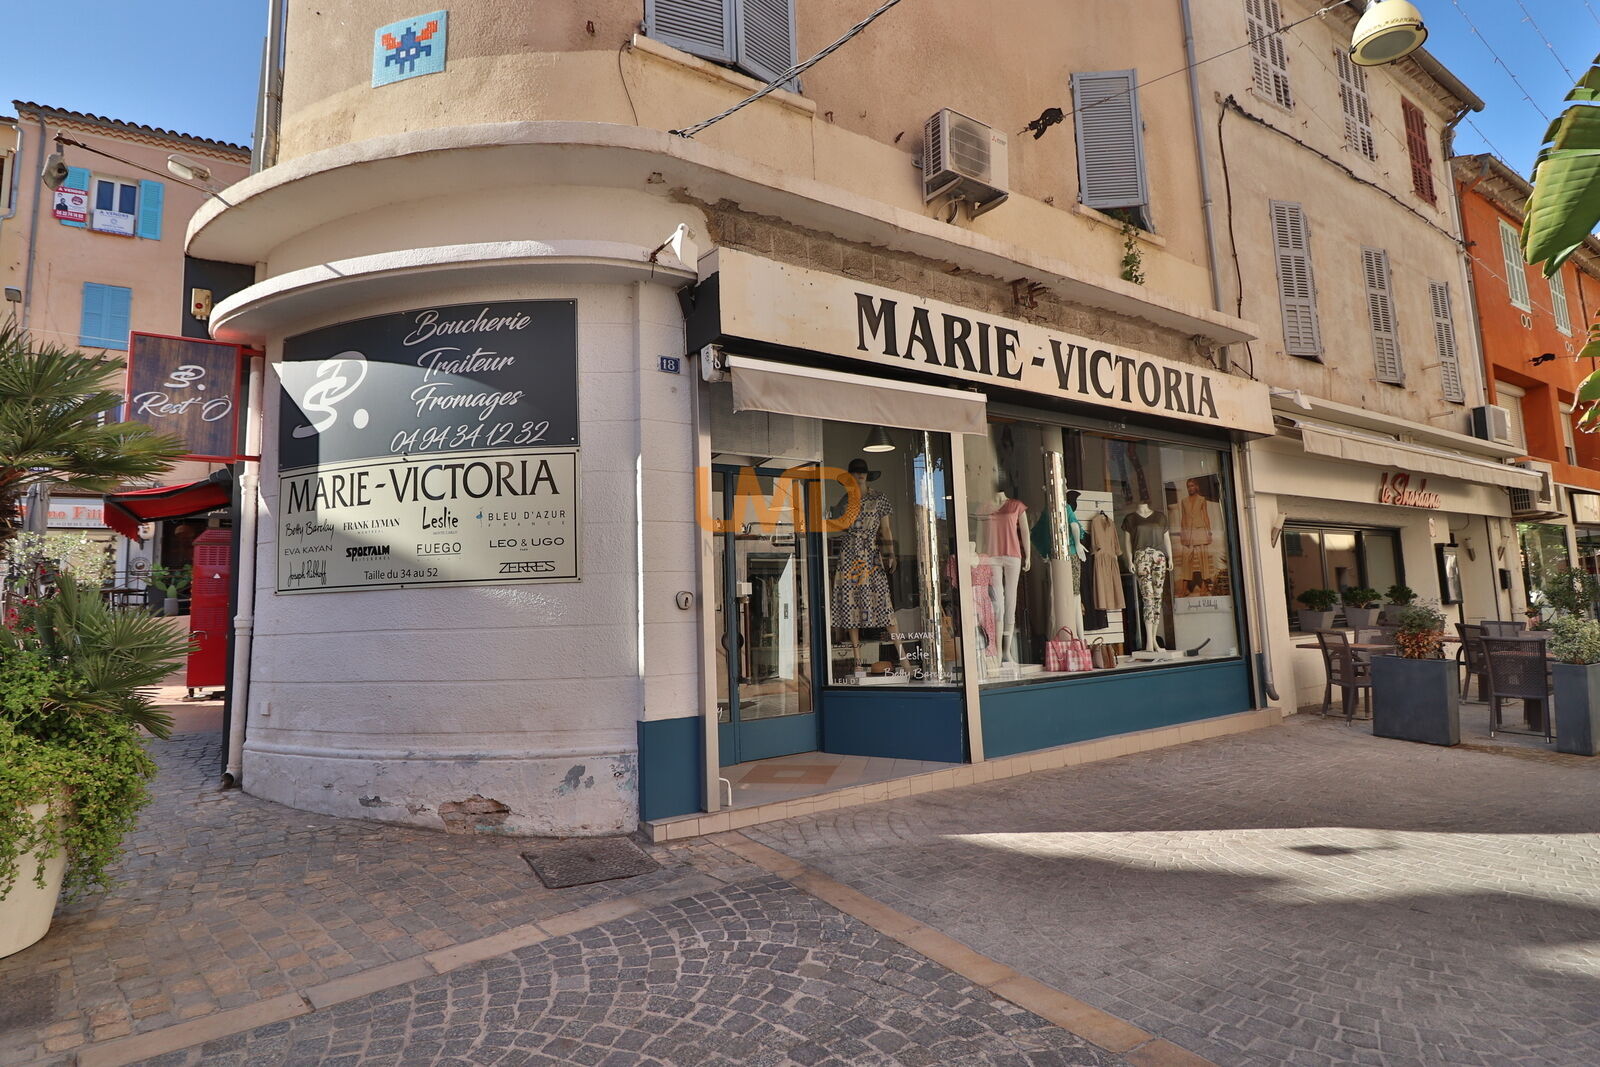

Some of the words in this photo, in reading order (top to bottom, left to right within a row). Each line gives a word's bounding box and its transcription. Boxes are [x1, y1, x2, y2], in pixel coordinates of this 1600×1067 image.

[403, 307, 532, 346] Boucherie
[416, 347, 516, 382] Traiteur
[662, 359, 676, 371] 18
[410, 382, 526, 421] Fromages
[390, 428, 421, 452] 04
[419, 425, 451, 450] 94
[449, 423, 485, 447] 34
[485, 422, 514, 446] 12
[513, 420, 550, 444] 32
[422, 506, 459, 530] Leslie
[488, 512, 517, 521] BLEU
[523, 510, 566, 520] D'AZUR
[305, 518, 335, 541] Barclay
[343, 520, 369, 531] FRANK
[371, 518, 400, 529] LYMAN
[416, 542, 462, 554] FUEGO
[489, 539, 518, 548] LEO
[520, 538, 528, 547] &
[531, 537, 565, 547] UGO
[284, 547, 300, 556] EVA
[302, 545, 333, 554] KAYAN
[364, 570, 385, 580] Taille
[386, 569, 399, 579] du
[400, 569, 411, 578] 34
[413, 570, 425, 578] au
[427, 568, 438, 577] 52
[499, 560, 556, 574] ZERRES
[899, 643, 930, 661] Leslie
